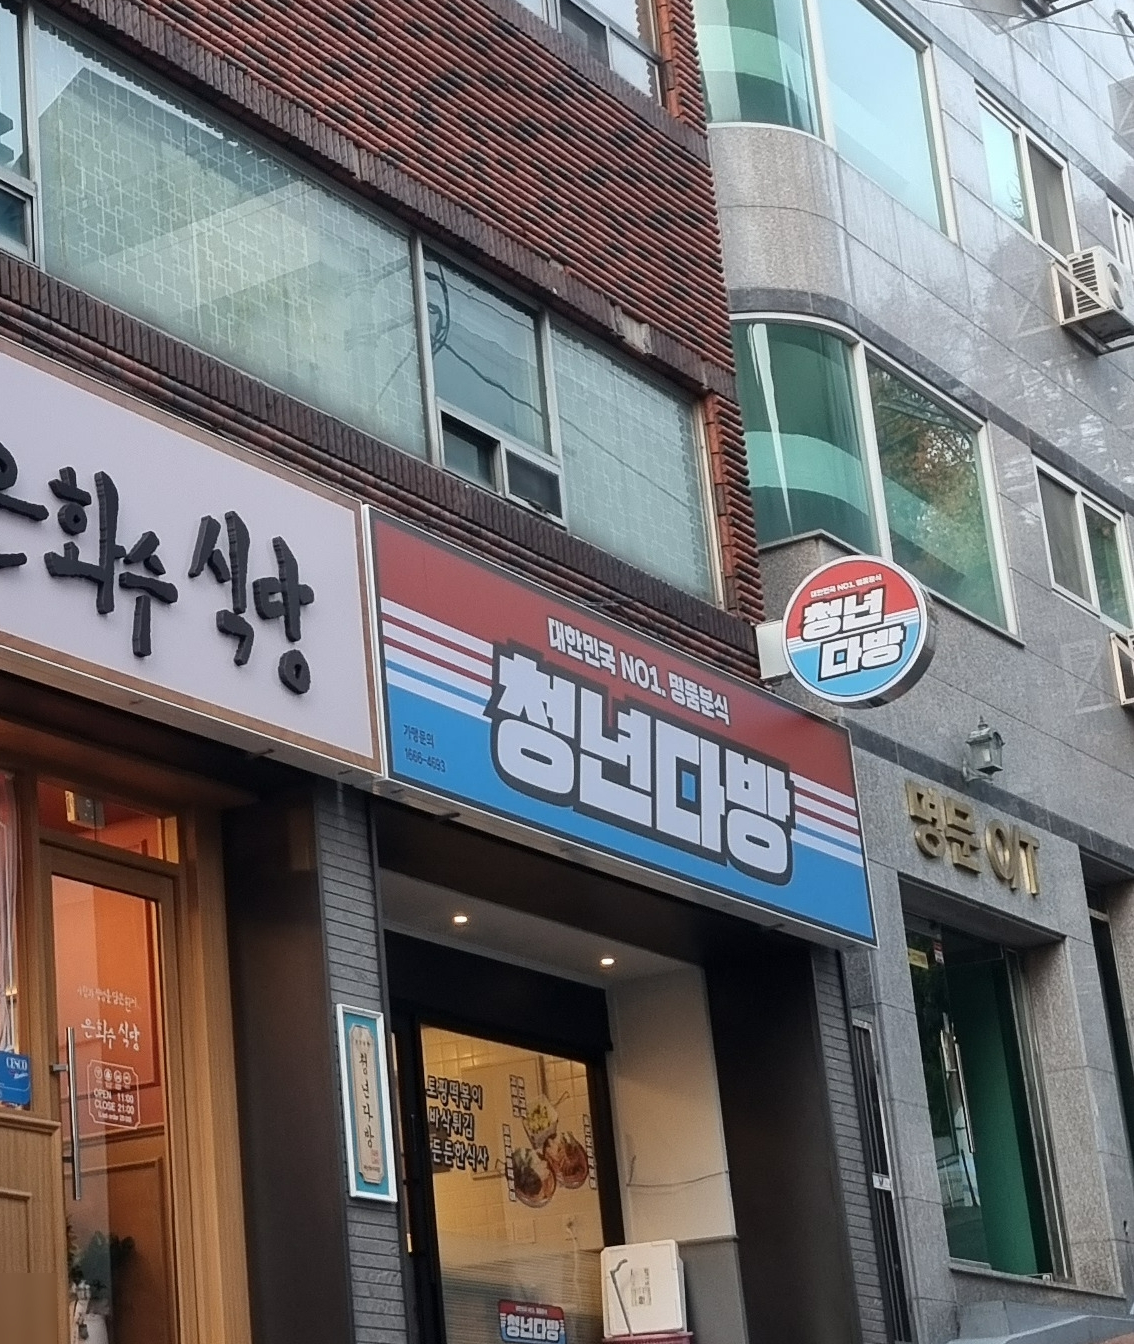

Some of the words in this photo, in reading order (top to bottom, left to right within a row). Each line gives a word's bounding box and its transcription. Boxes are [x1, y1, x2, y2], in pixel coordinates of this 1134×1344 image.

[188, 510, 315, 695] 식당
[802, 587, 884, 641] 청년
[819, 624, 905, 679] 다방
[547, 616, 616, 675] 대한민국
[668, 671, 731, 726] 명품분식
[496, 652, 792, 875] 청년다방
[904, 780, 983, 875] 명문
[80, 1018, 116, 1050] 은화수
[118, 1020, 140, 1052] 식당
[6, 1056, 28, 1071] CESCO
[93, 1087, 112, 1101] OPEN
[94, 1099, 116, 1112] CLOSE
[359, 1052, 375, 1149] 청년다방
[426, 1075, 483, 1110] 토핑떡볶이
[428, 1106, 475, 1141] 바삭튀김
[431, 1137, 489, 1172] 든든한식사
[506, 1313, 560, 1342] 청년다방
